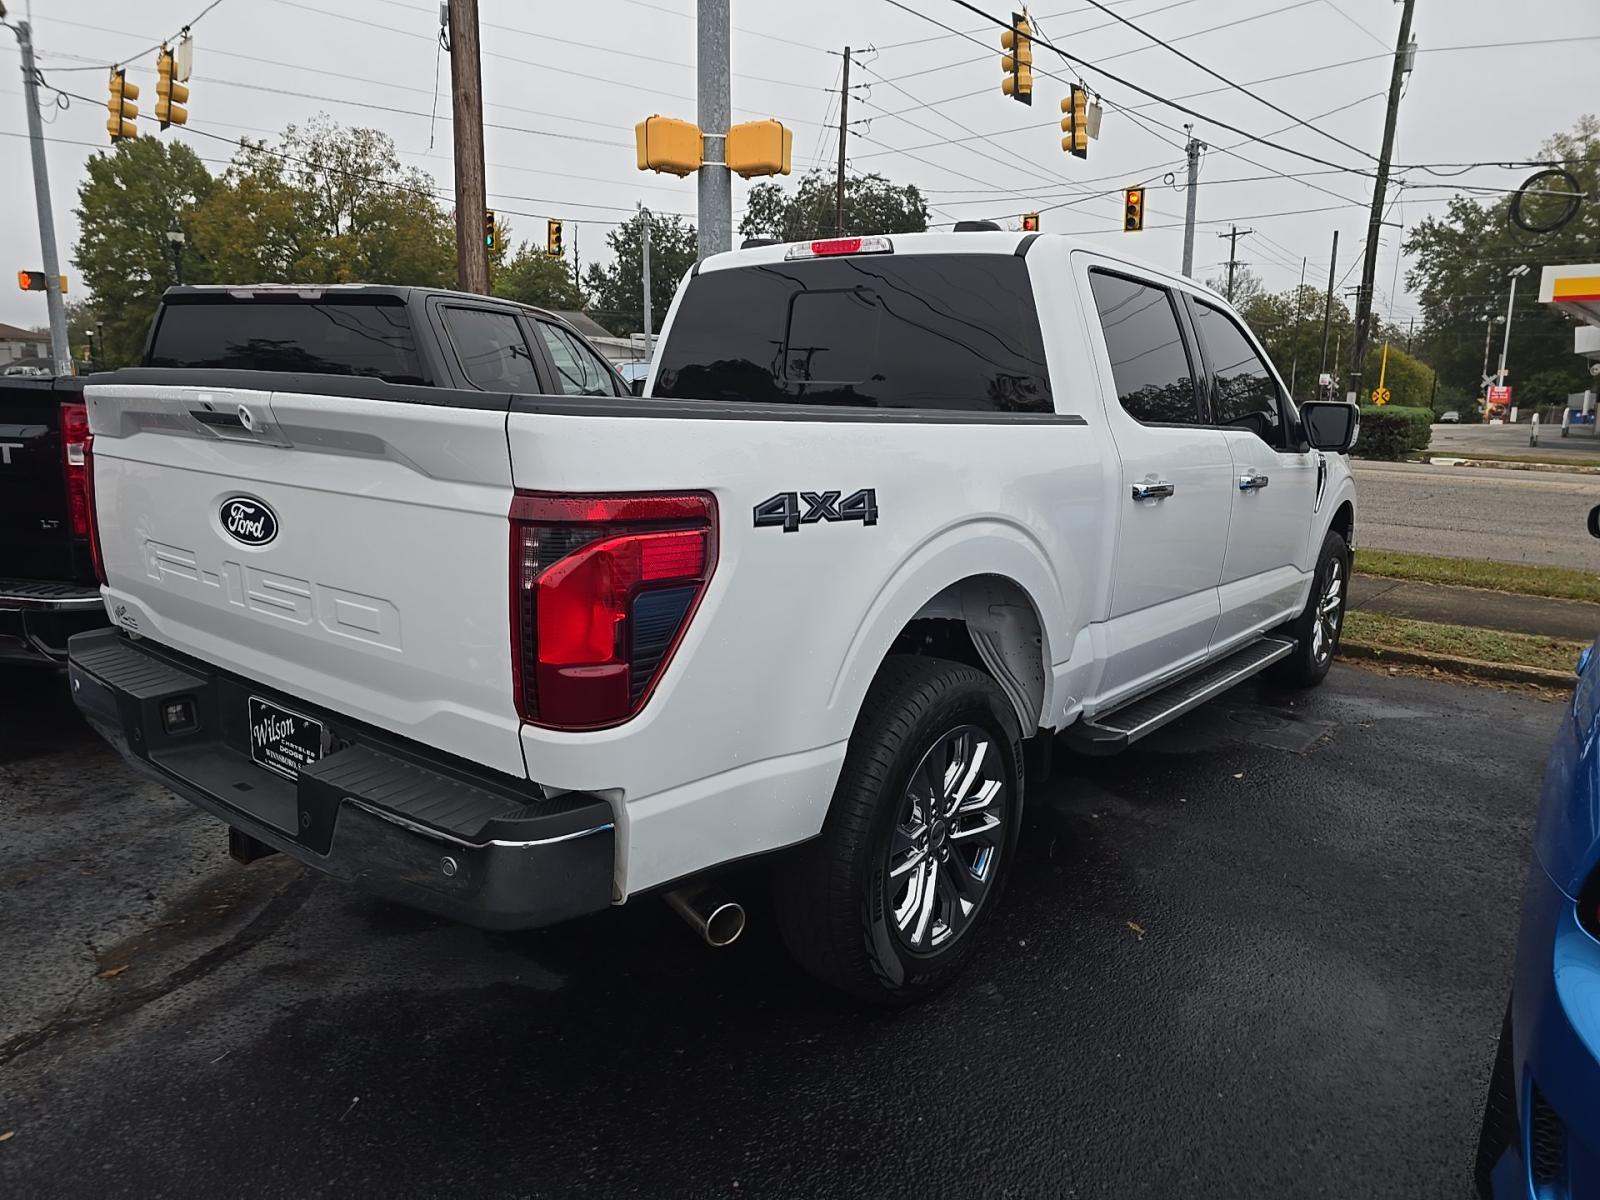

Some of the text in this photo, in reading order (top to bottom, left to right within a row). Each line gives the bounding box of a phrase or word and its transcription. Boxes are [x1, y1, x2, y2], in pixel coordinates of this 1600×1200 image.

[228, 503, 265, 538] Ford
[144, 538, 403, 653] F-150
[253, 714, 295, 747] Wilson
[280, 745, 303, 761] DODGE
